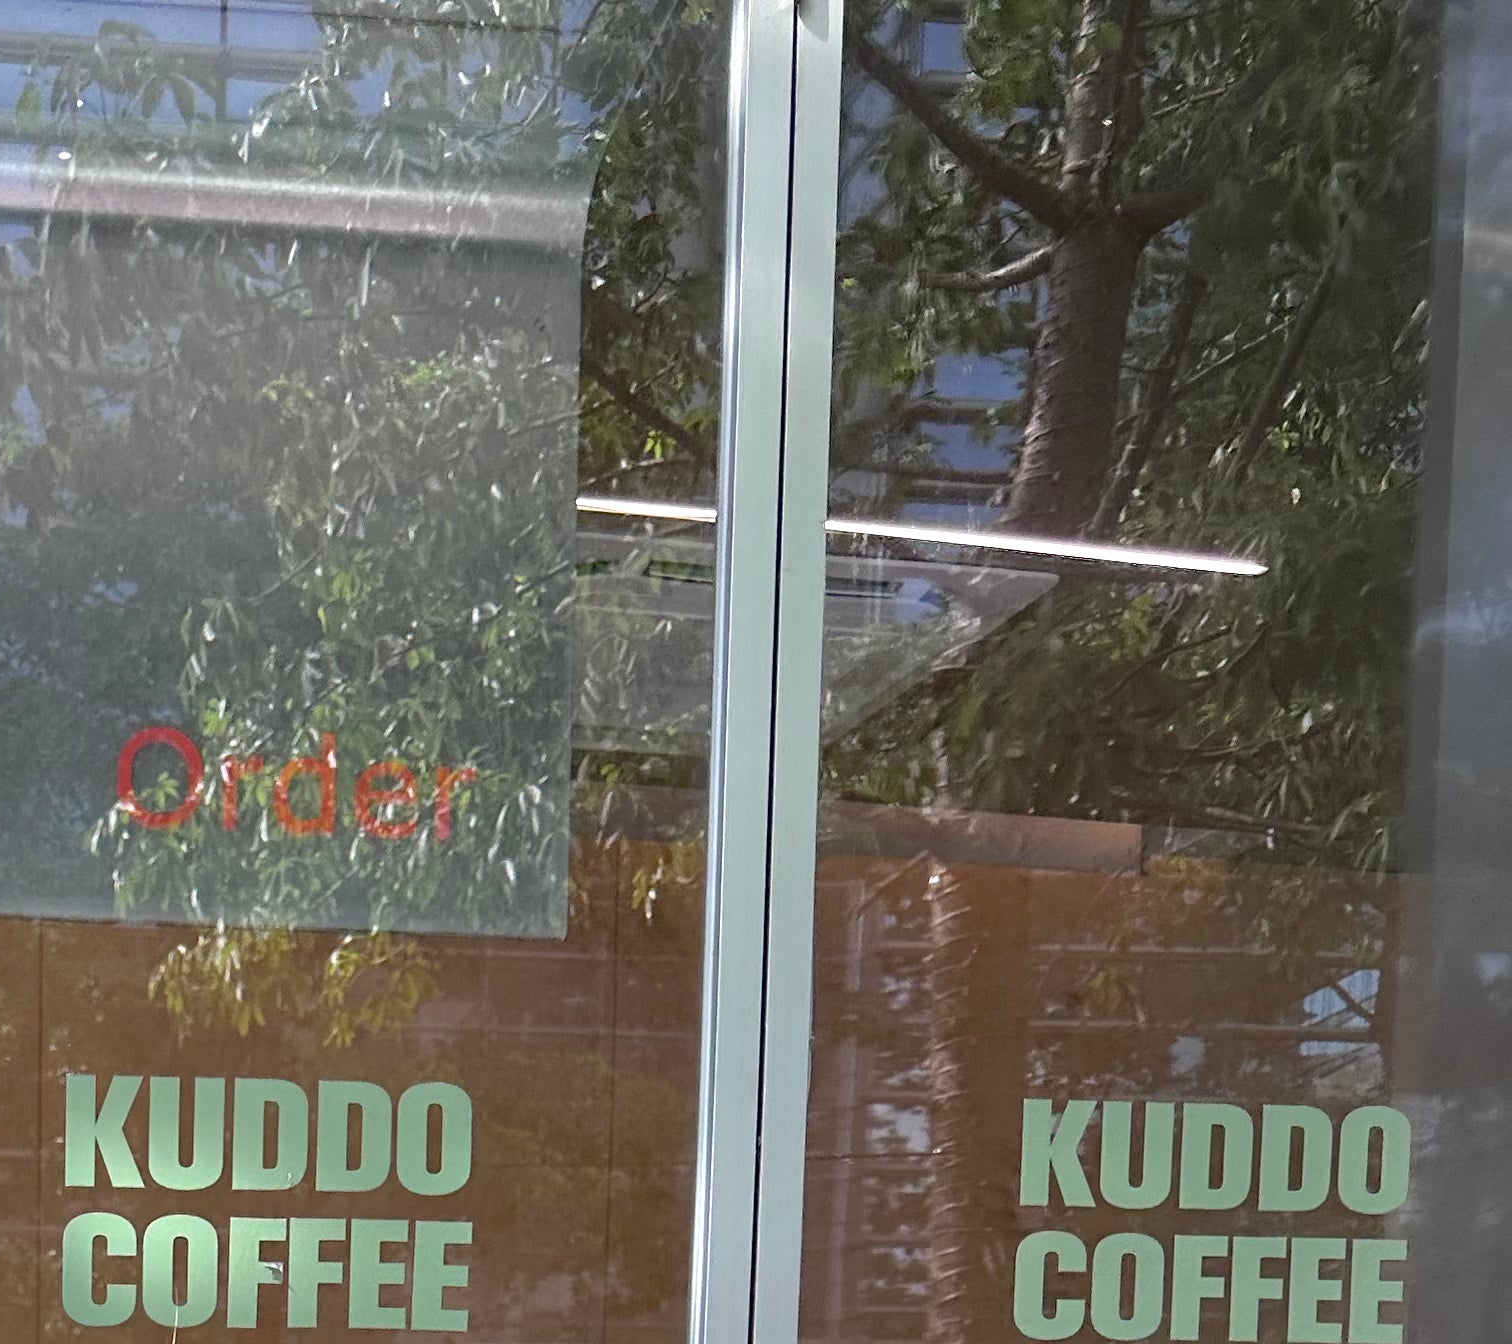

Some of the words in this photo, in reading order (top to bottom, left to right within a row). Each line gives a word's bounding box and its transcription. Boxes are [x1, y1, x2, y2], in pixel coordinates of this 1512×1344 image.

[117, 727, 476, 841] Order
[65, 1074, 473, 1195] KUDDO
[1019, 1098, 1411, 1214] KUDDO
[62, 1212, 473, 1332] COFFEE
[1013, 1230, 1407, 1344] COFFEE
